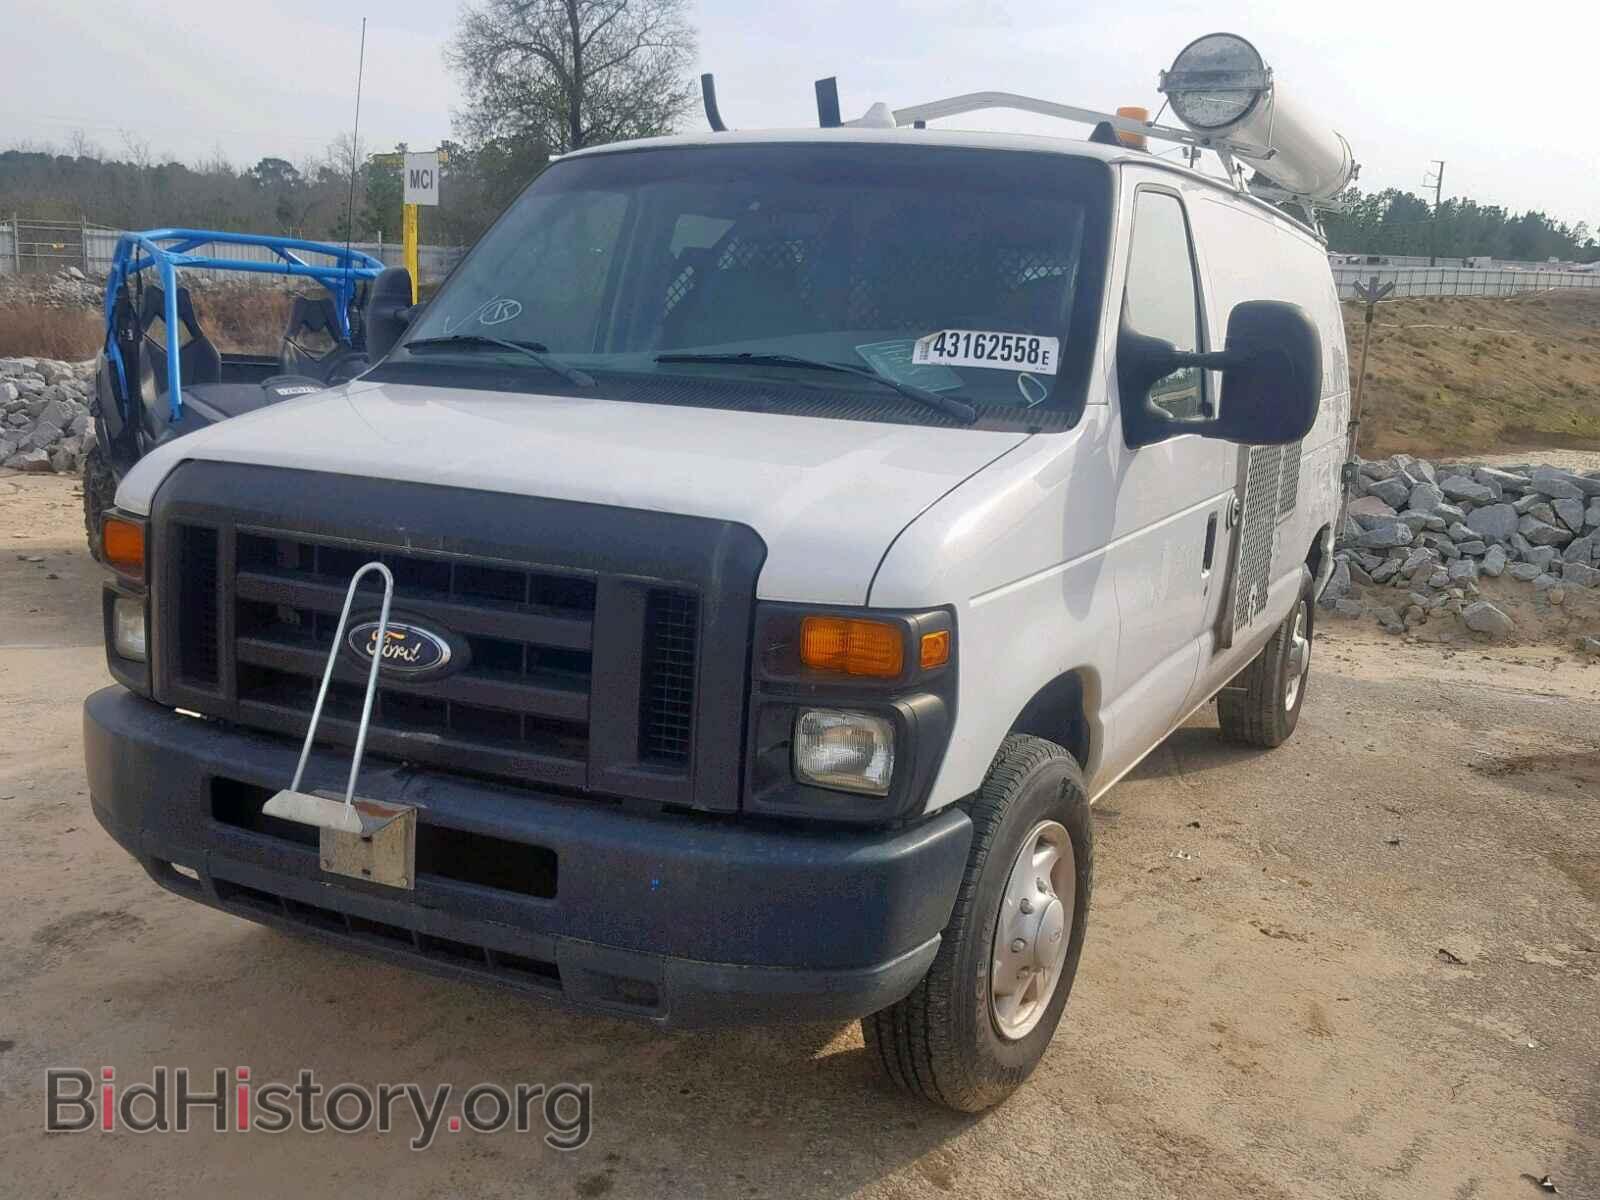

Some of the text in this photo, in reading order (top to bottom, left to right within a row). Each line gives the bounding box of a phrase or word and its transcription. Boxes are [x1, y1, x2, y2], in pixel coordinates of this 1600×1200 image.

[410, 169, 433, 190] MCI
[933, 331, 1040, 365] 43162558
[365, 628, 422, 662] Ford
